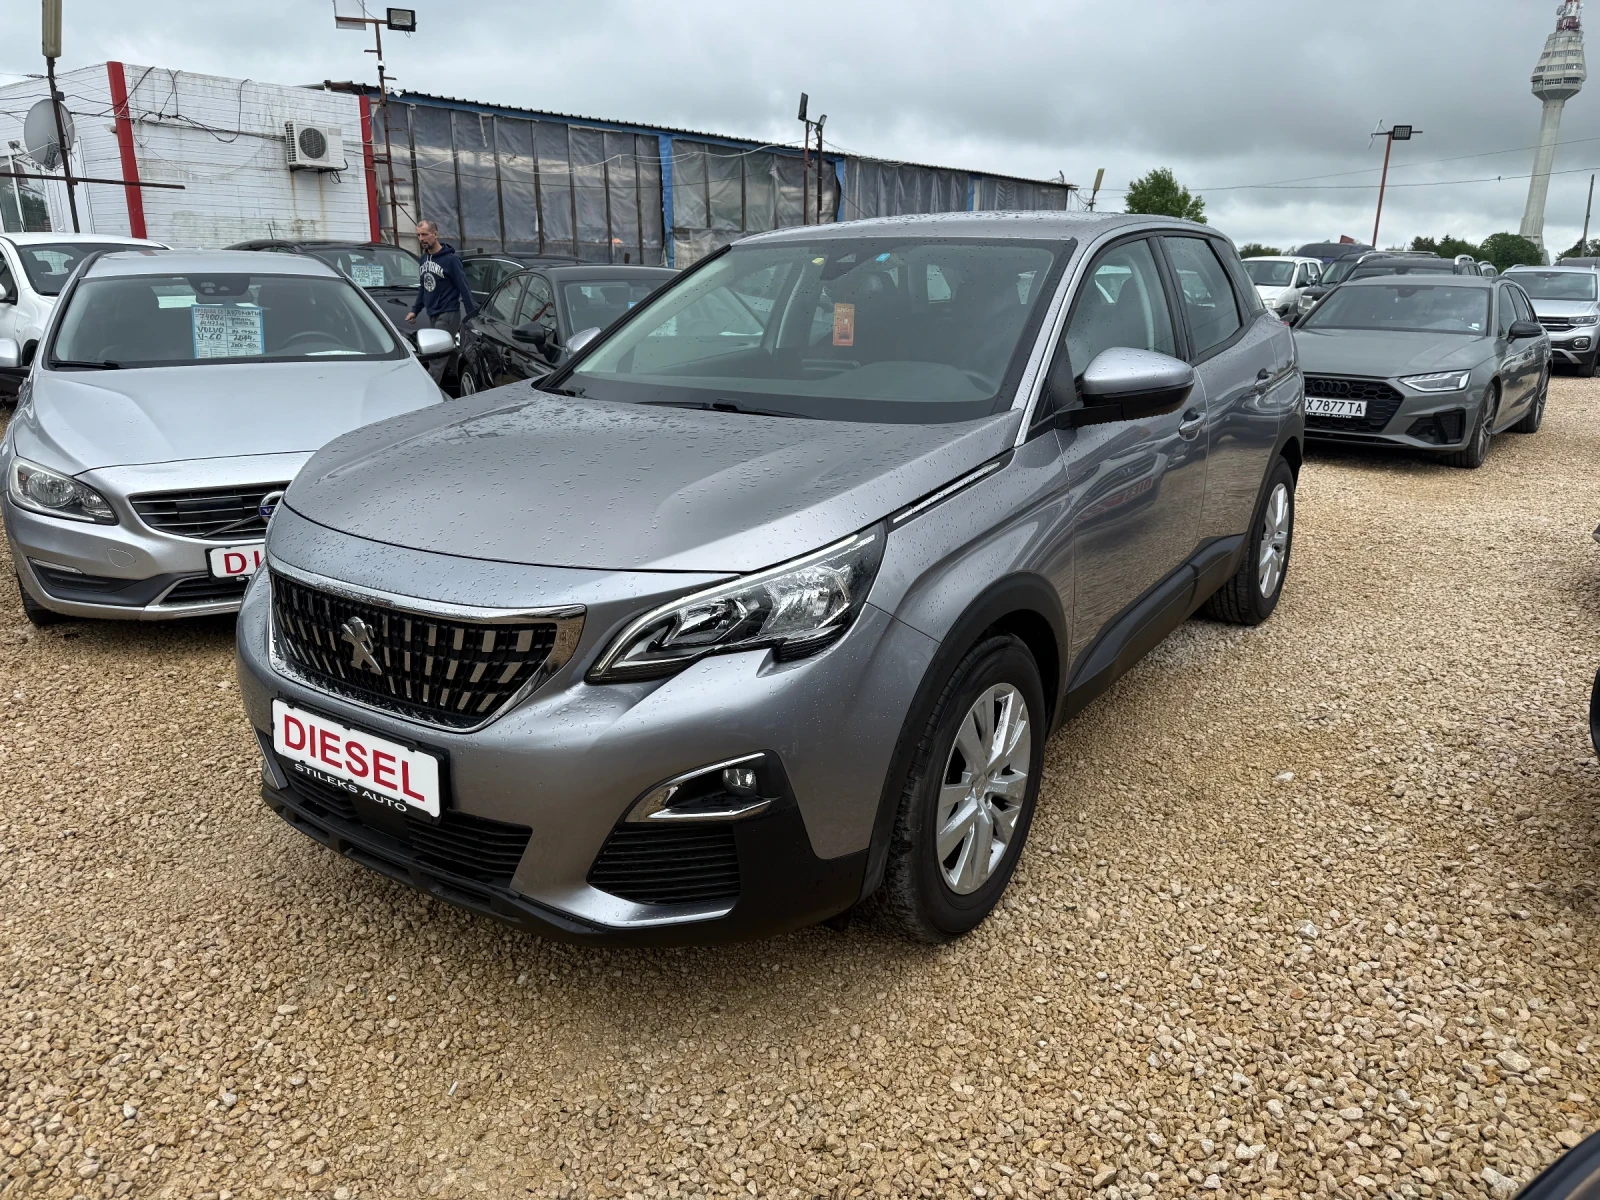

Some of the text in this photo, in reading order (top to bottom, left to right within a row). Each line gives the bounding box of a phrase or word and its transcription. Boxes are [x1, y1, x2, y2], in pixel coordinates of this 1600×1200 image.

[283, 713, 426, 802] DIESEL
[294, 763, 408, 812] STILEKS AUTO
